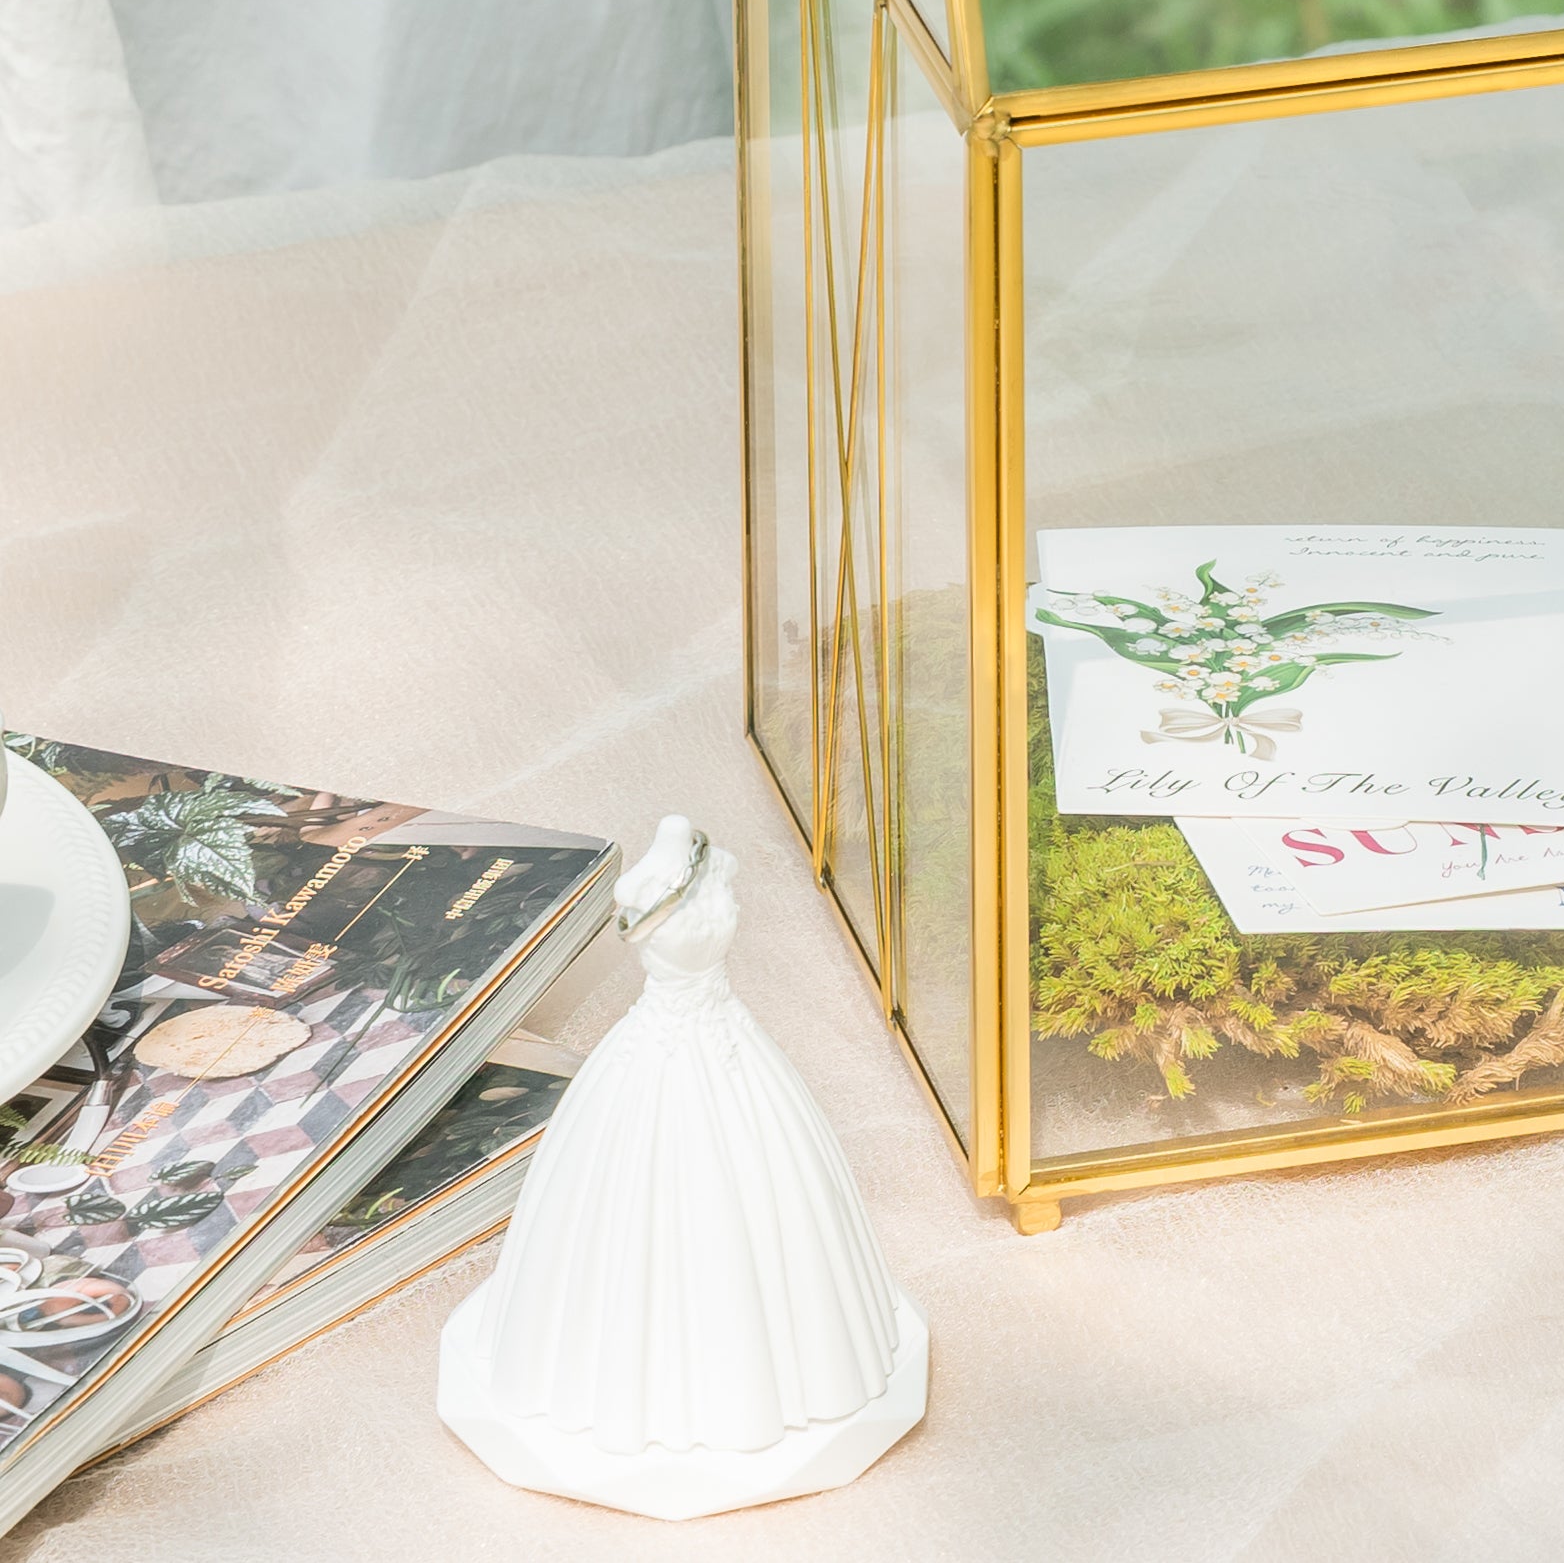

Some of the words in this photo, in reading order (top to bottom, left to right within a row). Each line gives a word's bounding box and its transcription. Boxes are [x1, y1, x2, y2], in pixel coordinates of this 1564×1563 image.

[1380, 535, 1405, 548] of
[1289, 549, 1412, 557] Innocent
[1423, 549, 1474, 558] and
[1085, 769, 1201, 799] Lily
[1223, 770, 1296, 799] Of
[1301, 773, 1409, 796] The
[1494, 853, 1529, 865] Are
[198, 927, 280, 990] Satoshi
[259, 836, 367, 926] Kawamoto
